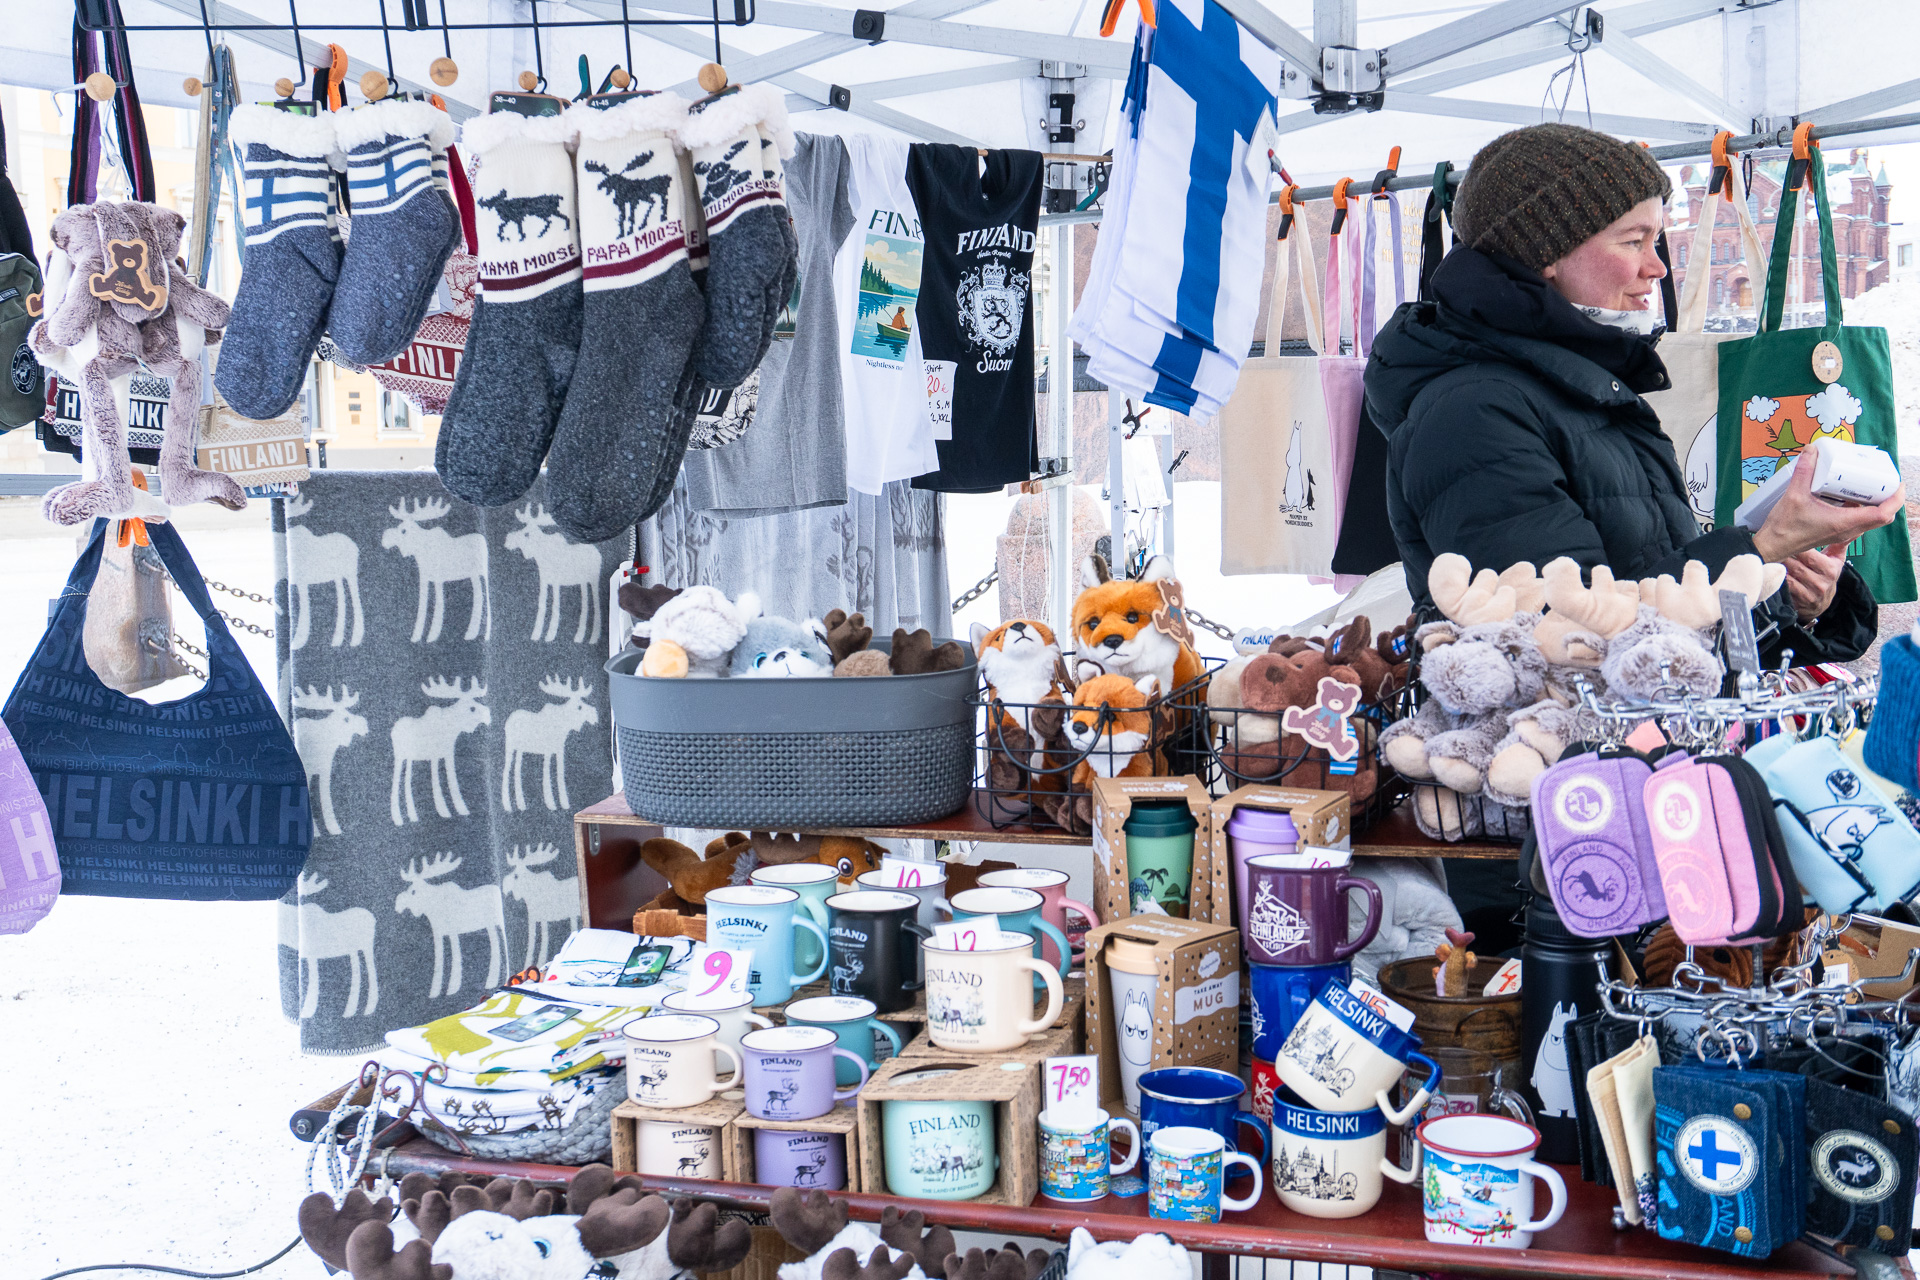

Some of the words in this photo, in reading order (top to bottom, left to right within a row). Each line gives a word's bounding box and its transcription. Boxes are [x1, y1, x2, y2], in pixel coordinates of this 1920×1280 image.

[956, 223, 1036, 255] FINLAND
[480, 258, 519, 277] MAMA
[524, 244, 576, 272] MOOSE
[587, 243, 630, 263] PAPA
[208, 441, 299, 472] FINLAND
[20, 699, 79, 724] HELSINKI
[80, 713, 142, 736] HELSINKI
[146, 725, 211, 739] HELSINKI
[214, 719, 273, 738] HELSINKI
[37, 772, 261, 845] HELSINKI
[75, 856, 144, 870] HELSINKI
[147, 860, 214, 874] HELSINKI
[218, 863, 282, 876] HELSINKI
[81, 869, 149, 884] HELSINKI
[152, 873, 219, 887] HELSINKI
[715, 917, 769, 933] HELSINKI
[829, 927, 868, 943] FINLAND
[1255, 925, 1295, 940] FINLAND
[695, 950, 733, 997] 9
[926, 969, 983, 988] FINLAND
[1193, 986, 1208, 995] TAKE
[1208, 982, 1224, 991] AWAY
[1193, 992, 1224, 1012] MUG
[1324, 985, 1388, 1039] HELSINKI
[633, 1047, 672, 1058] FINLAND
[760, 1057, 803, 1067] FINLAND
[908, 1114, 981, 1136] FINLAND
[1286, 1110, 1360, 1133] HELSINKI
[671, 1128, 713, 1139] FINLAND
[787, 1135, 829, 1147] FINLAND
